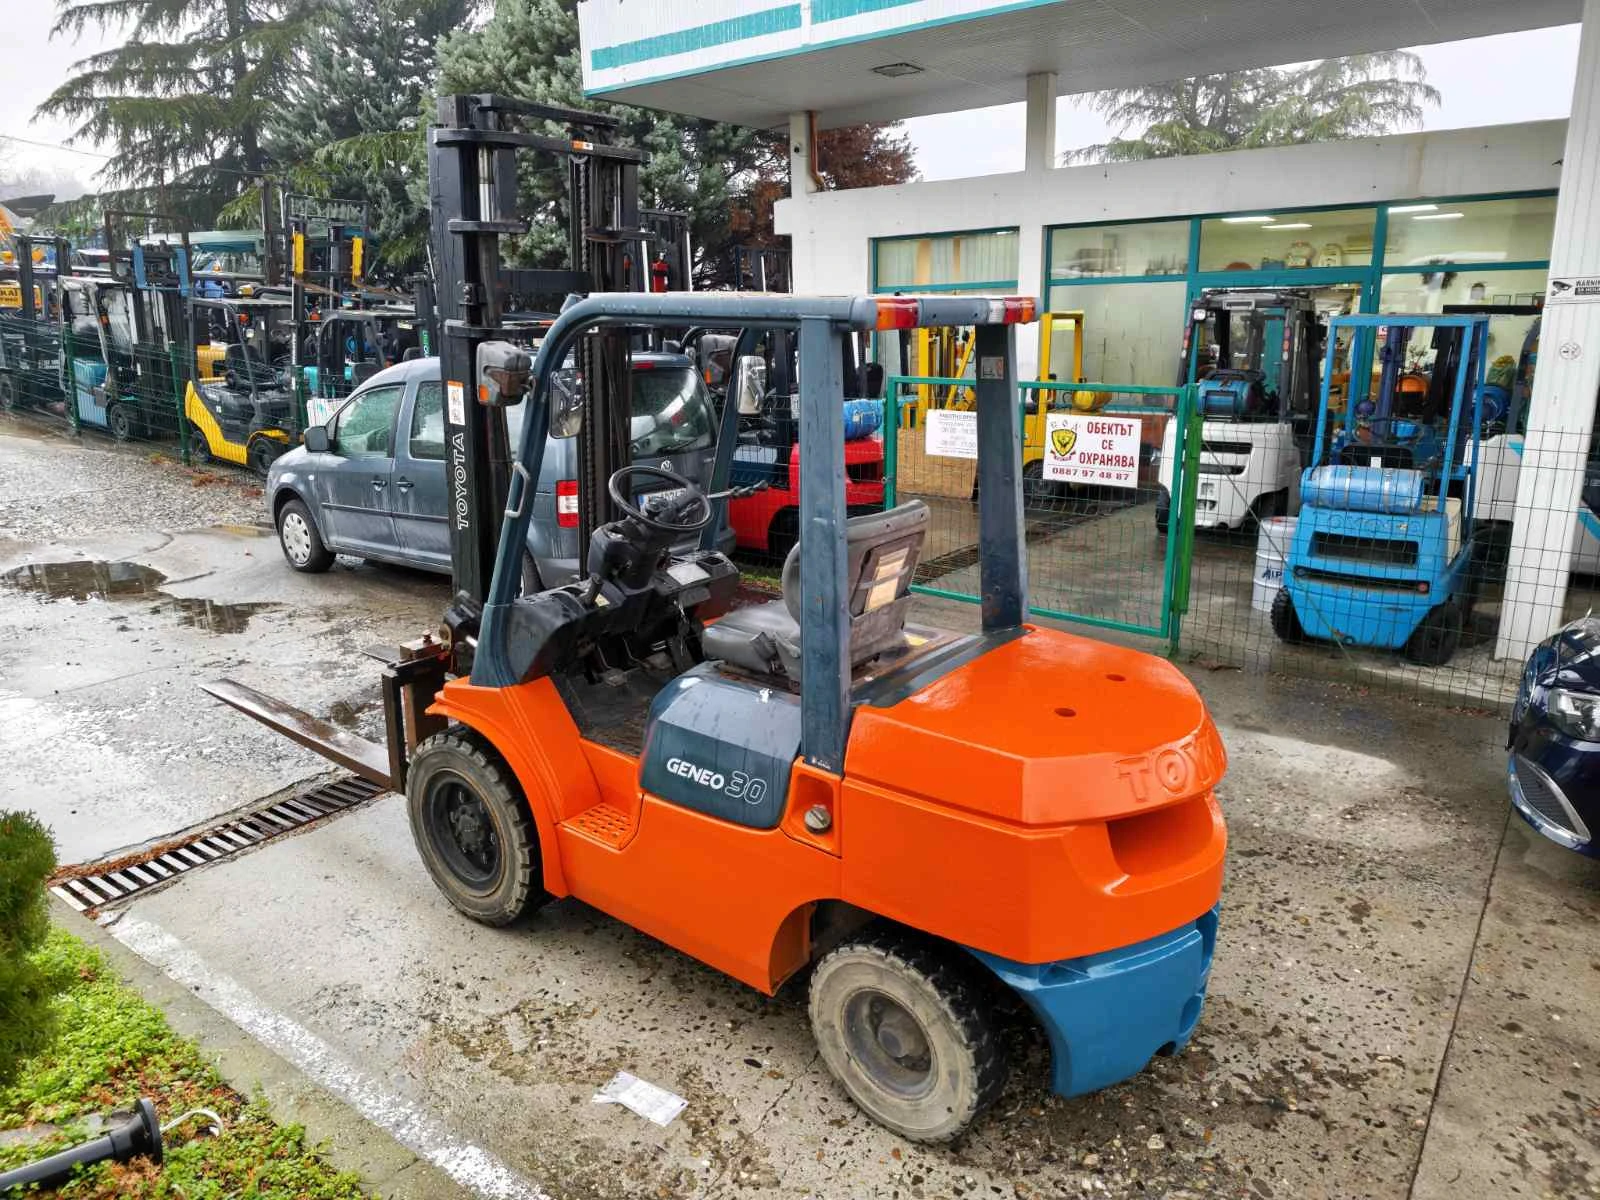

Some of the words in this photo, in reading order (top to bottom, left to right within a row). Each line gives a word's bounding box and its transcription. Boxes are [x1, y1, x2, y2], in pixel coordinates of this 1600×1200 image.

[1087, 421, 1133, 437] ОБЕКТЪТ
[1101, 439, 1114, 450] СЕ
[1079, 451, 1135, 468] ОХРАНЯВА
[1052, 467, 1079, 476] 0887
[453, 432, 469, 530] TOYOTA
[666, 758, 725, 790] GENEO
[724, 770, 767, 805] 30
